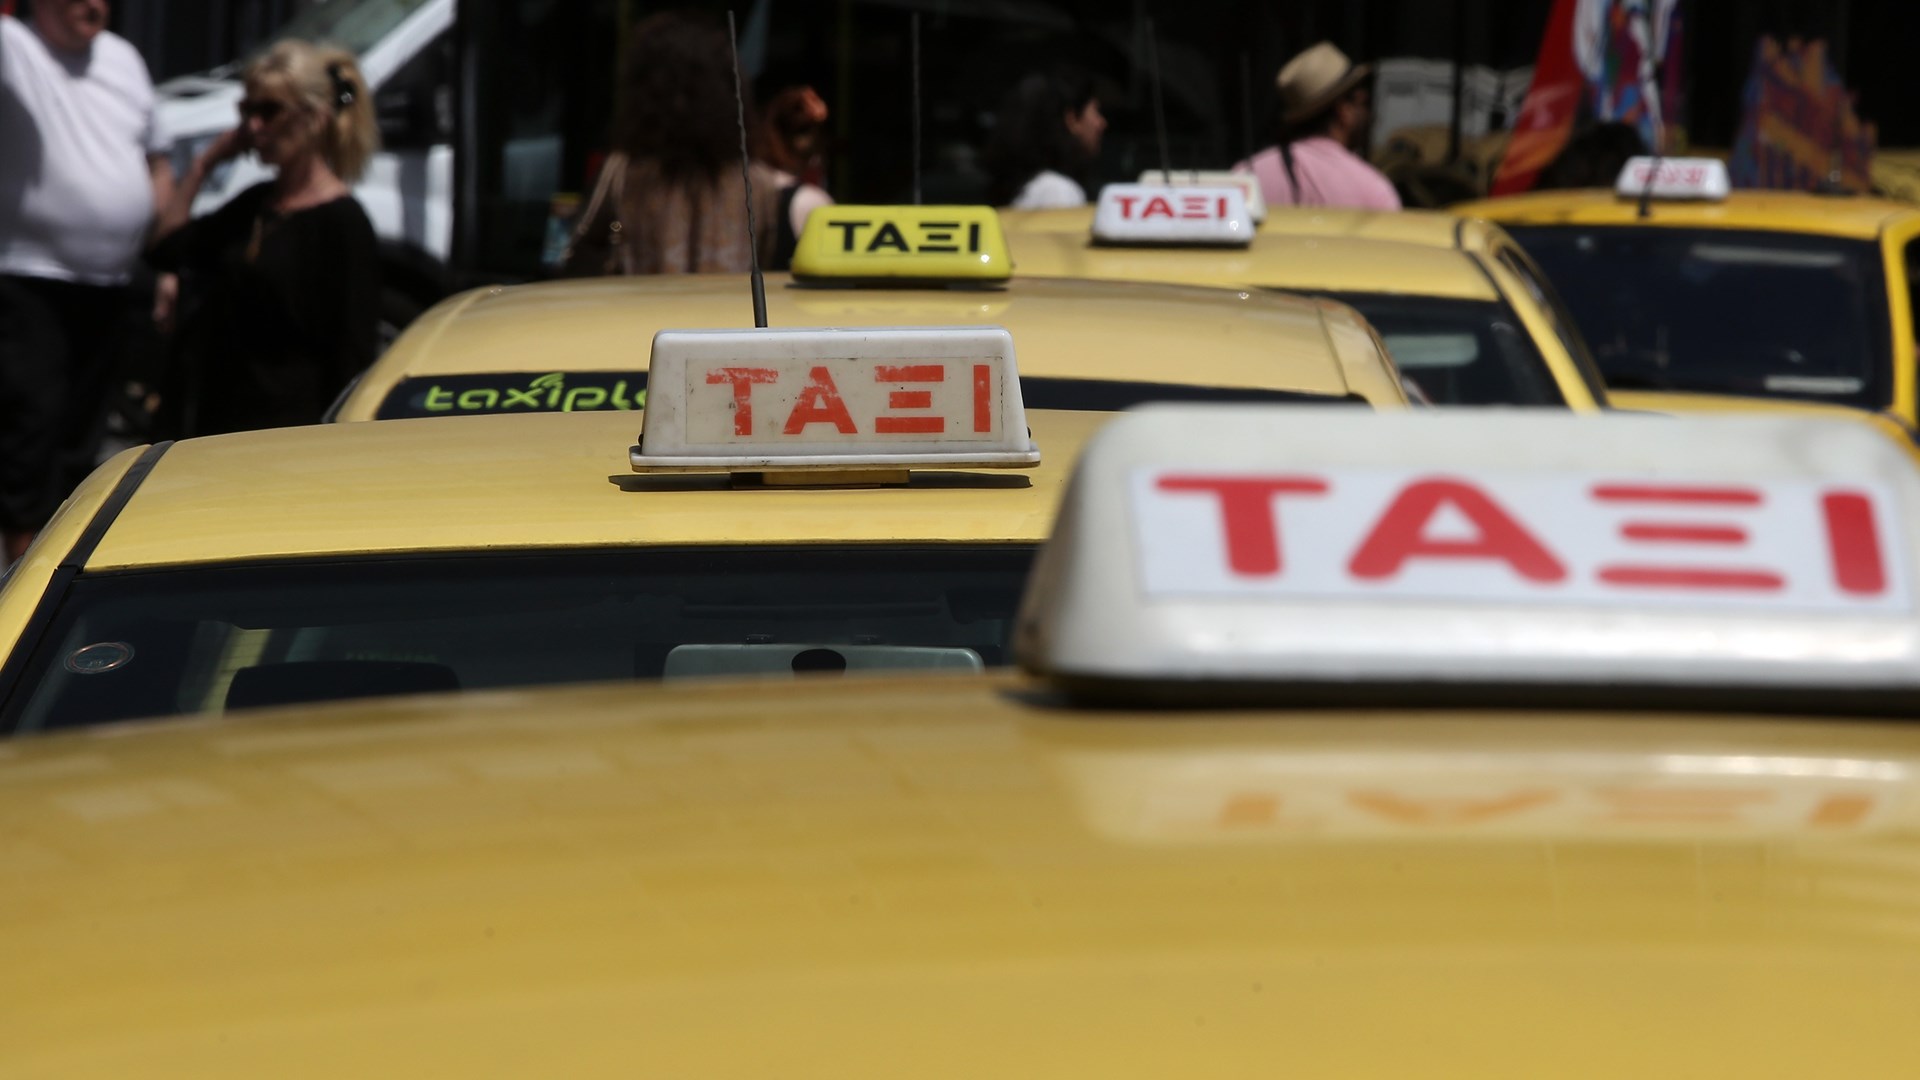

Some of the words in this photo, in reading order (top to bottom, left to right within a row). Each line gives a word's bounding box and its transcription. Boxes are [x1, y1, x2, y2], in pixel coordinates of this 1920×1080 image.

[1114, 195, 1229, 219] ΤΑΞΙ
[828, 220, 980, 252] ΤΑΞΙ
[705, 364, 991, 436] ΤΑΞΙ
[1154, 473, 1887, 595] ΤΑΞΙ
